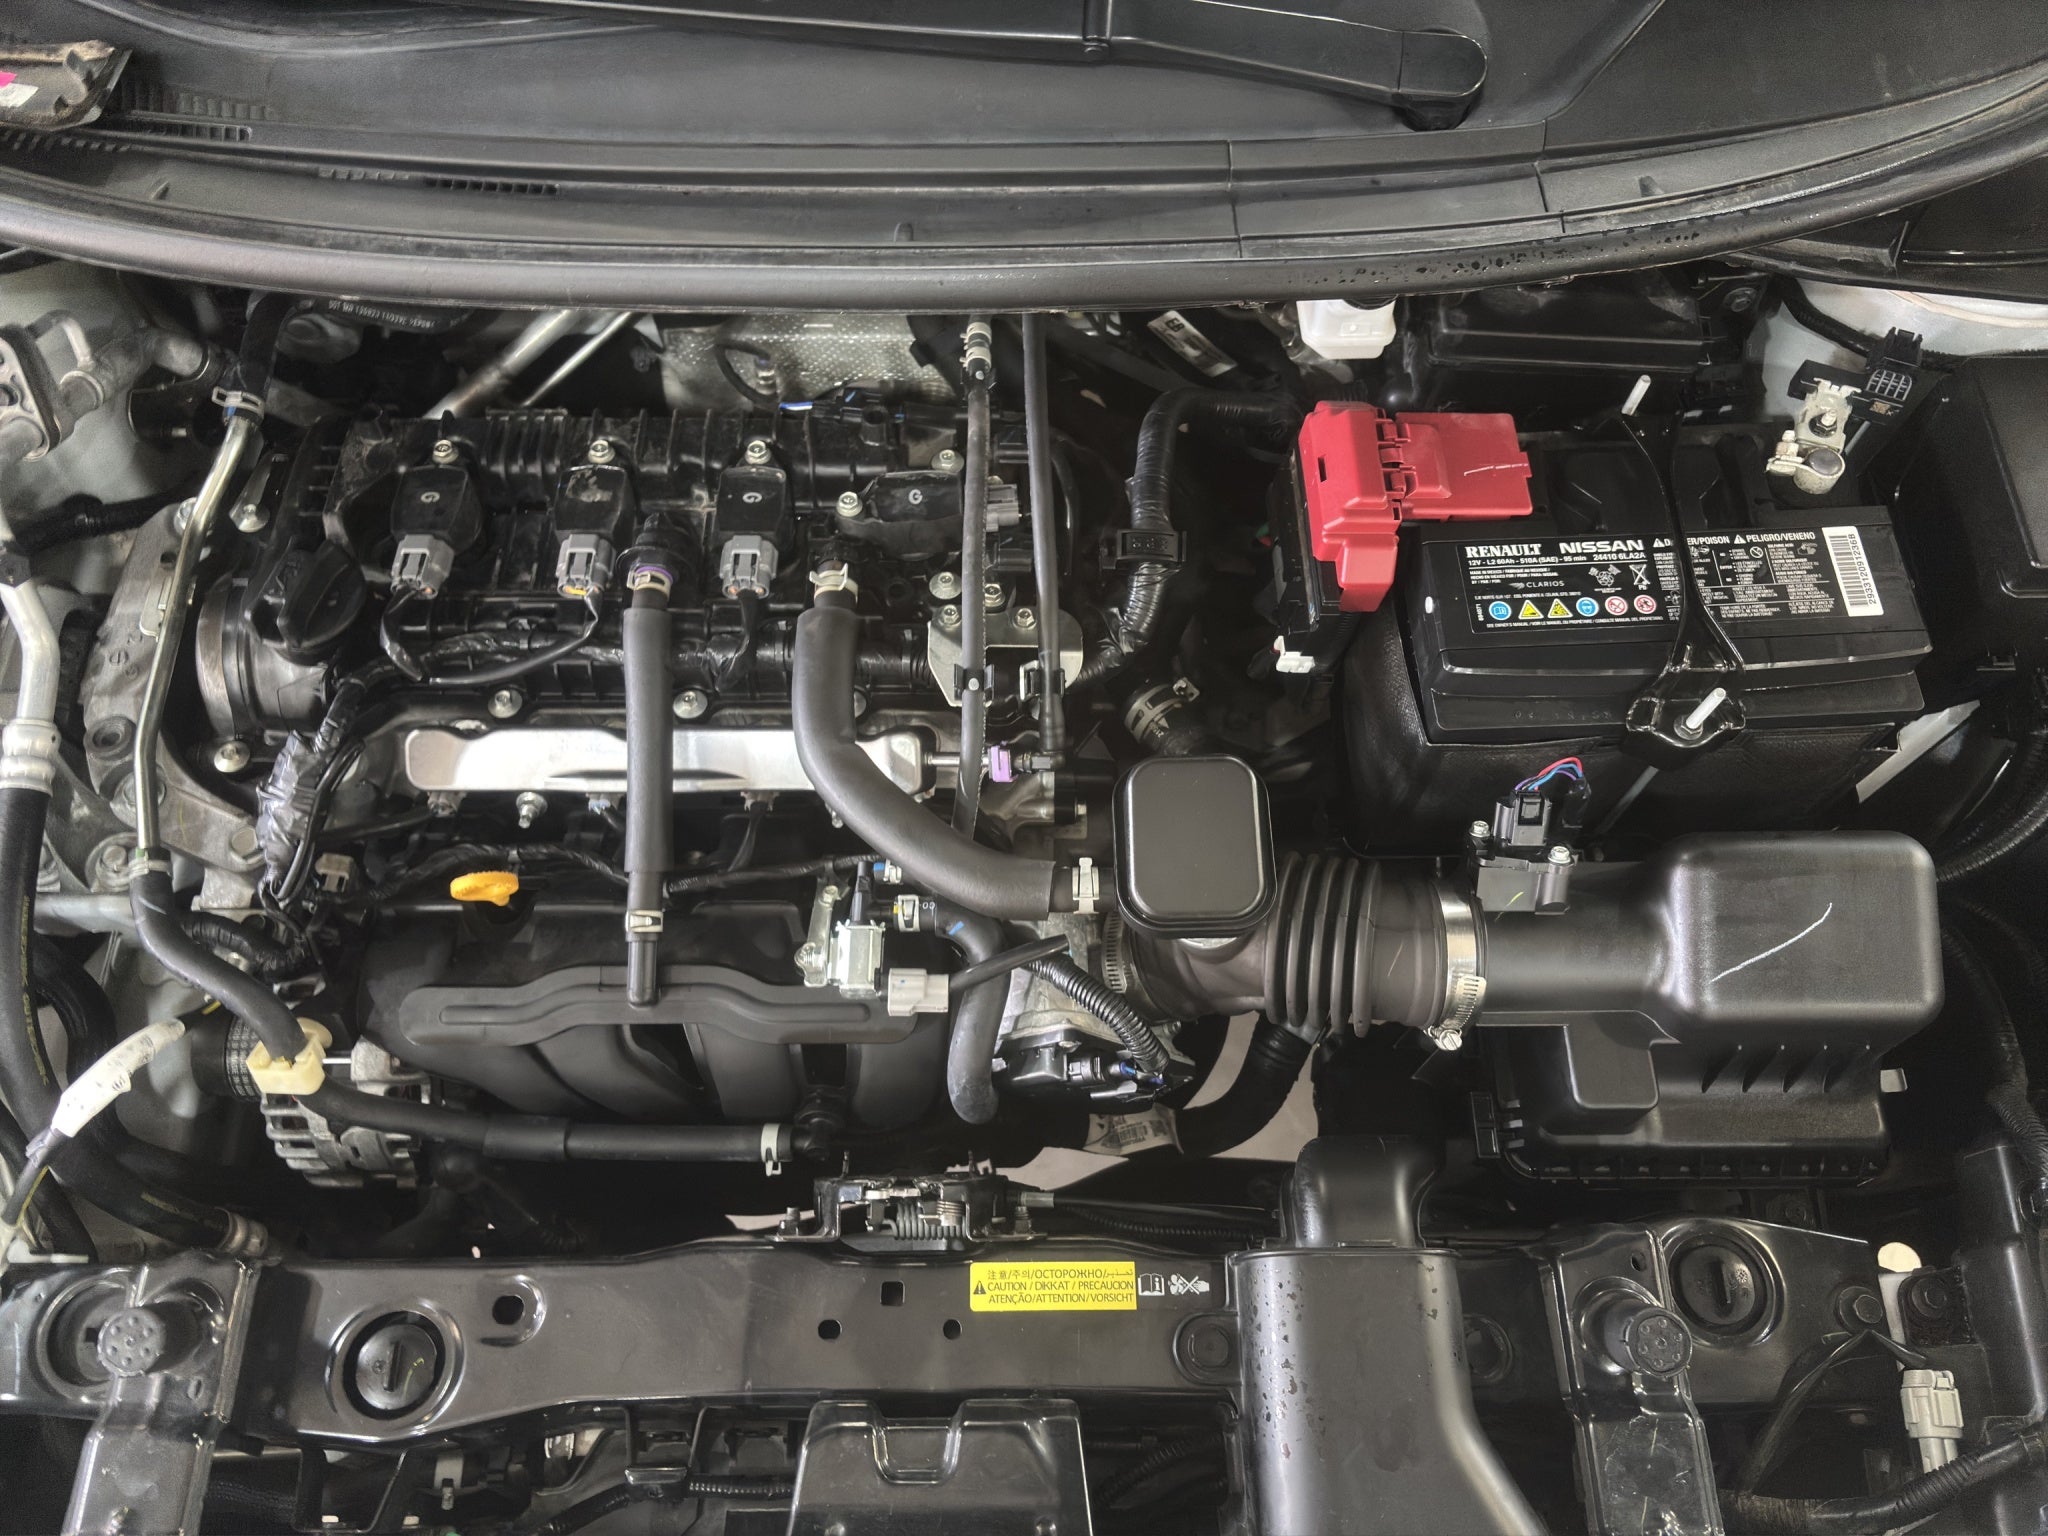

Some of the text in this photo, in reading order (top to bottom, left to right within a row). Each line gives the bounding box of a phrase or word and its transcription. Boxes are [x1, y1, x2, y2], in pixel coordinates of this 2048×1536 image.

[908, 489, 923, 504] G
[1746, 531, 1816, 543] PELIGRO/VENENO
[1464, 539, 1645, 559] RENAULT NISSAN
[1593, 553, 1618, 561] 24410
[1618, 552, 1646, 560] 6LA2A
[1526, 580, 1565, 588] CLARIOS
[987, 1281, 1027, 1291] CAUTION
